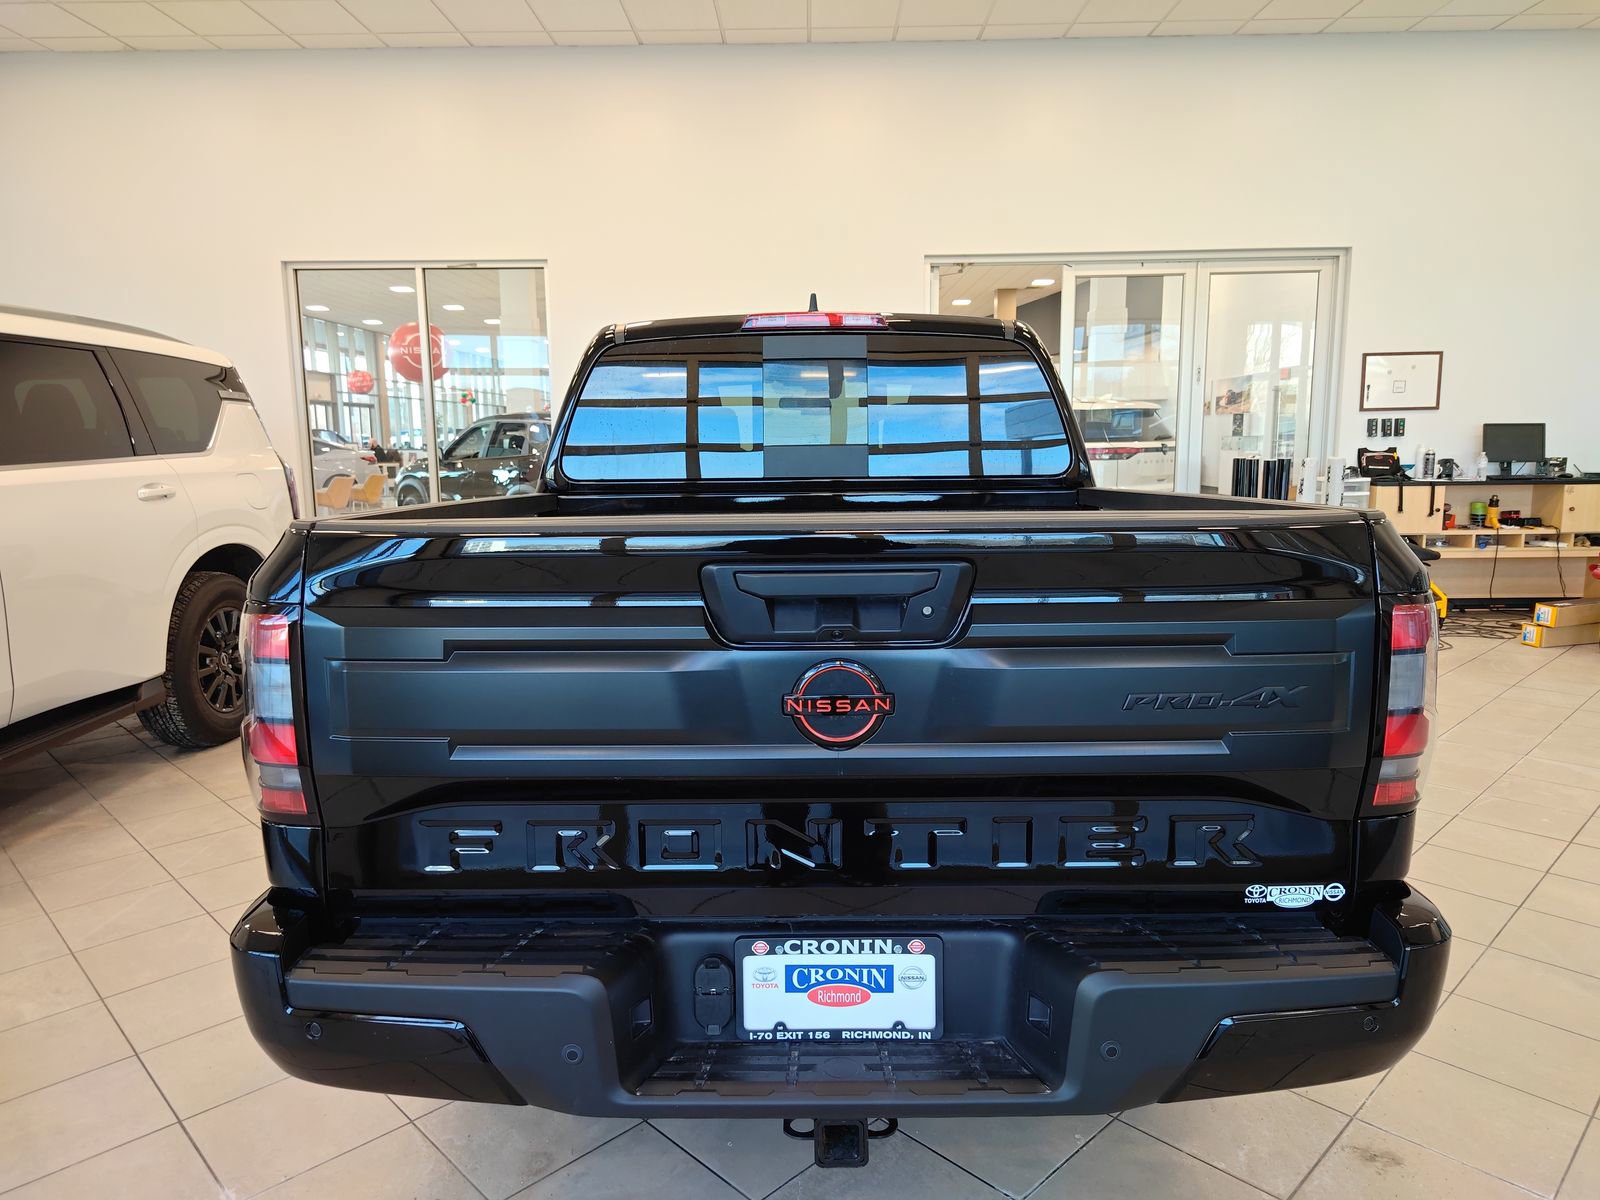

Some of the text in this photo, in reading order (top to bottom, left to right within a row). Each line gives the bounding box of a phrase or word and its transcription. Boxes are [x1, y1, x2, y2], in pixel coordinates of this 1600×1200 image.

[787, 698, 890, 713] NISSAN
[1121, 685, 1312, 711] PRO-4X
[418, 812, 1263, 873] FRONTIER
[1269, 886, 1321, 897] CRONIN
[783, 939, 893, 955] CRONIN
[791, 967, 887, 989] CRONIN
[817, 990, 861, 1003] Richmond
[749, 1031, 932, 1040] I-70 EXIT 156 RICHMOND, IN
